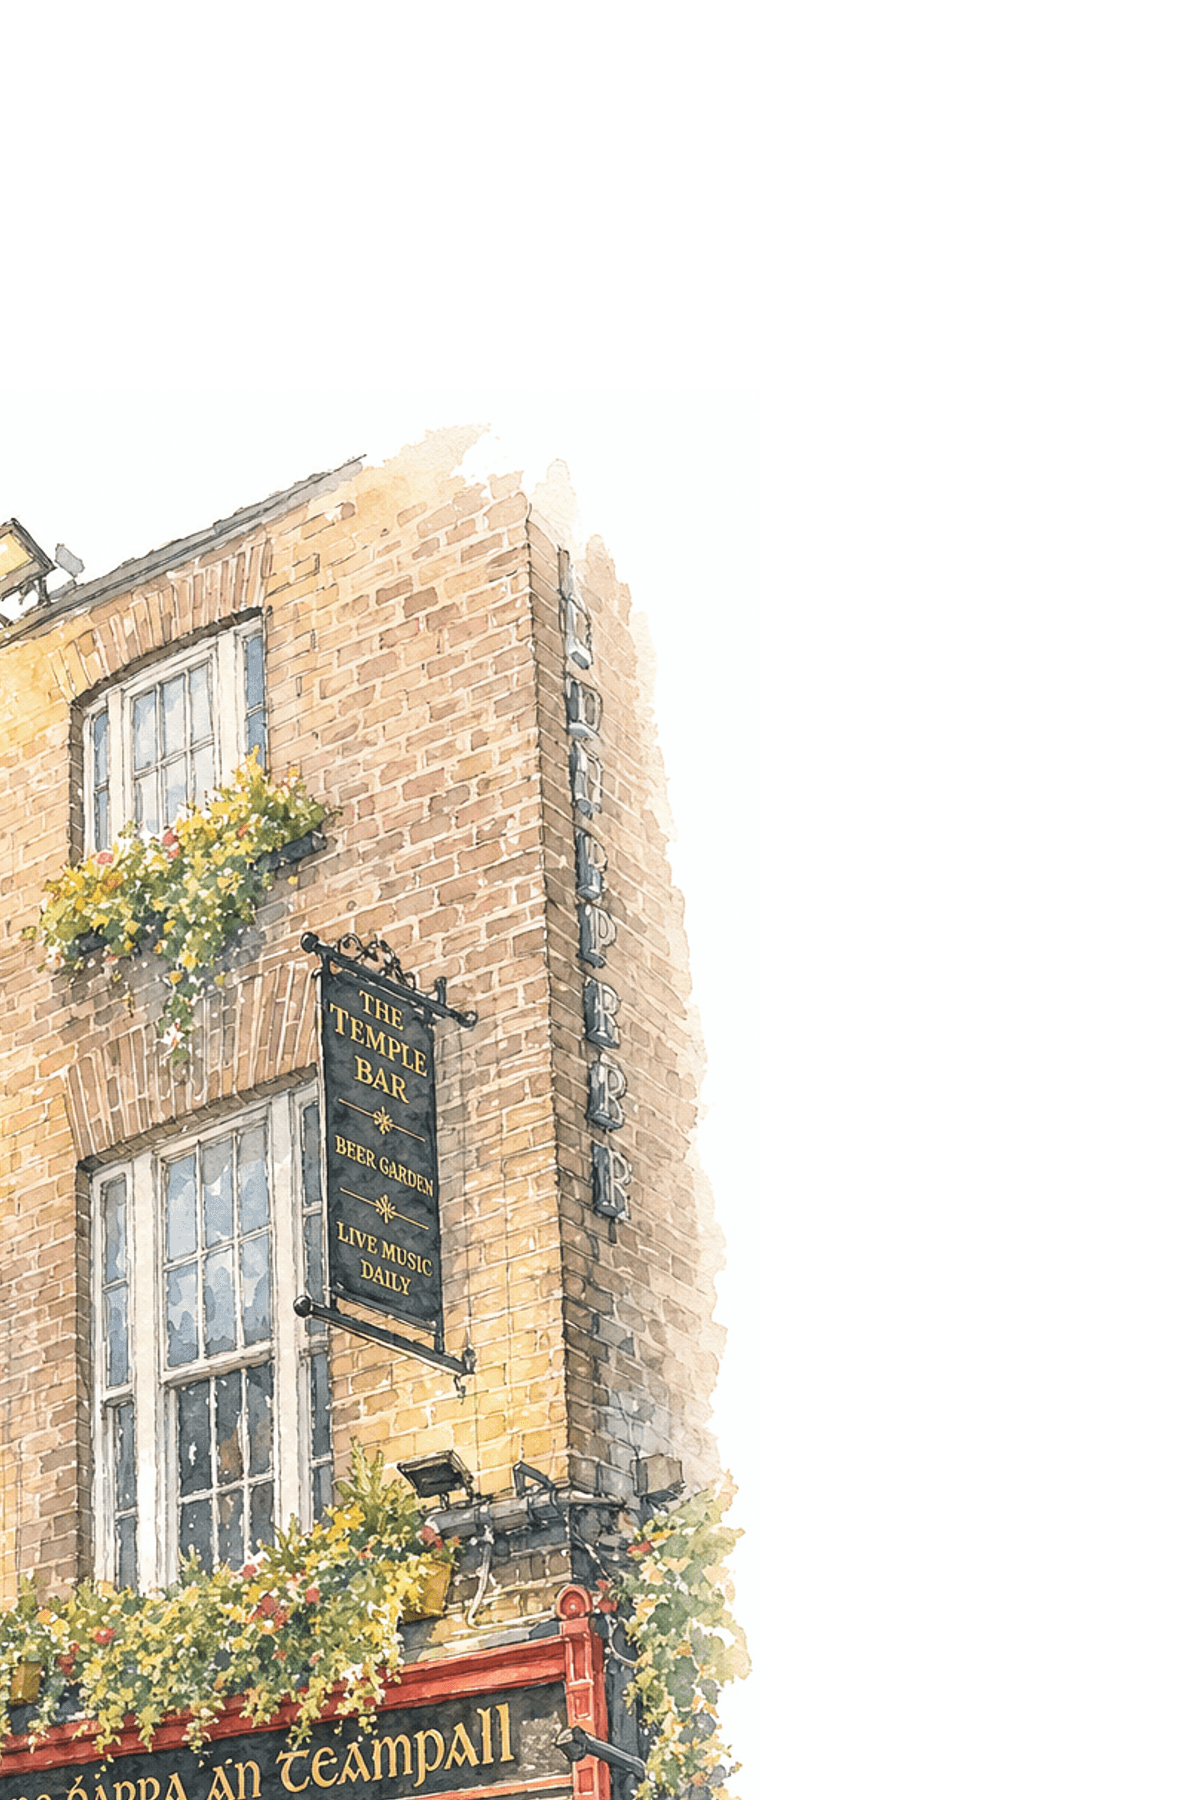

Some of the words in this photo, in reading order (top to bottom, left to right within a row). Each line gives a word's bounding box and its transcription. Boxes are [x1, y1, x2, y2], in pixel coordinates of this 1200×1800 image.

[359, 989, 404, 1031] THE
[330, 1003, 428, 1078] TEMPLE
[354, 1055, 410, 1104] BAR
[335, 1135, 378, 1172] BEER
[379, 1159, 434, 1198] GARDEN
[336, 1221, 379, 1256] LIVE
[381, 1242, 434, 1277] MUSIC
[361, 1259, 412, 1296] DAILY
